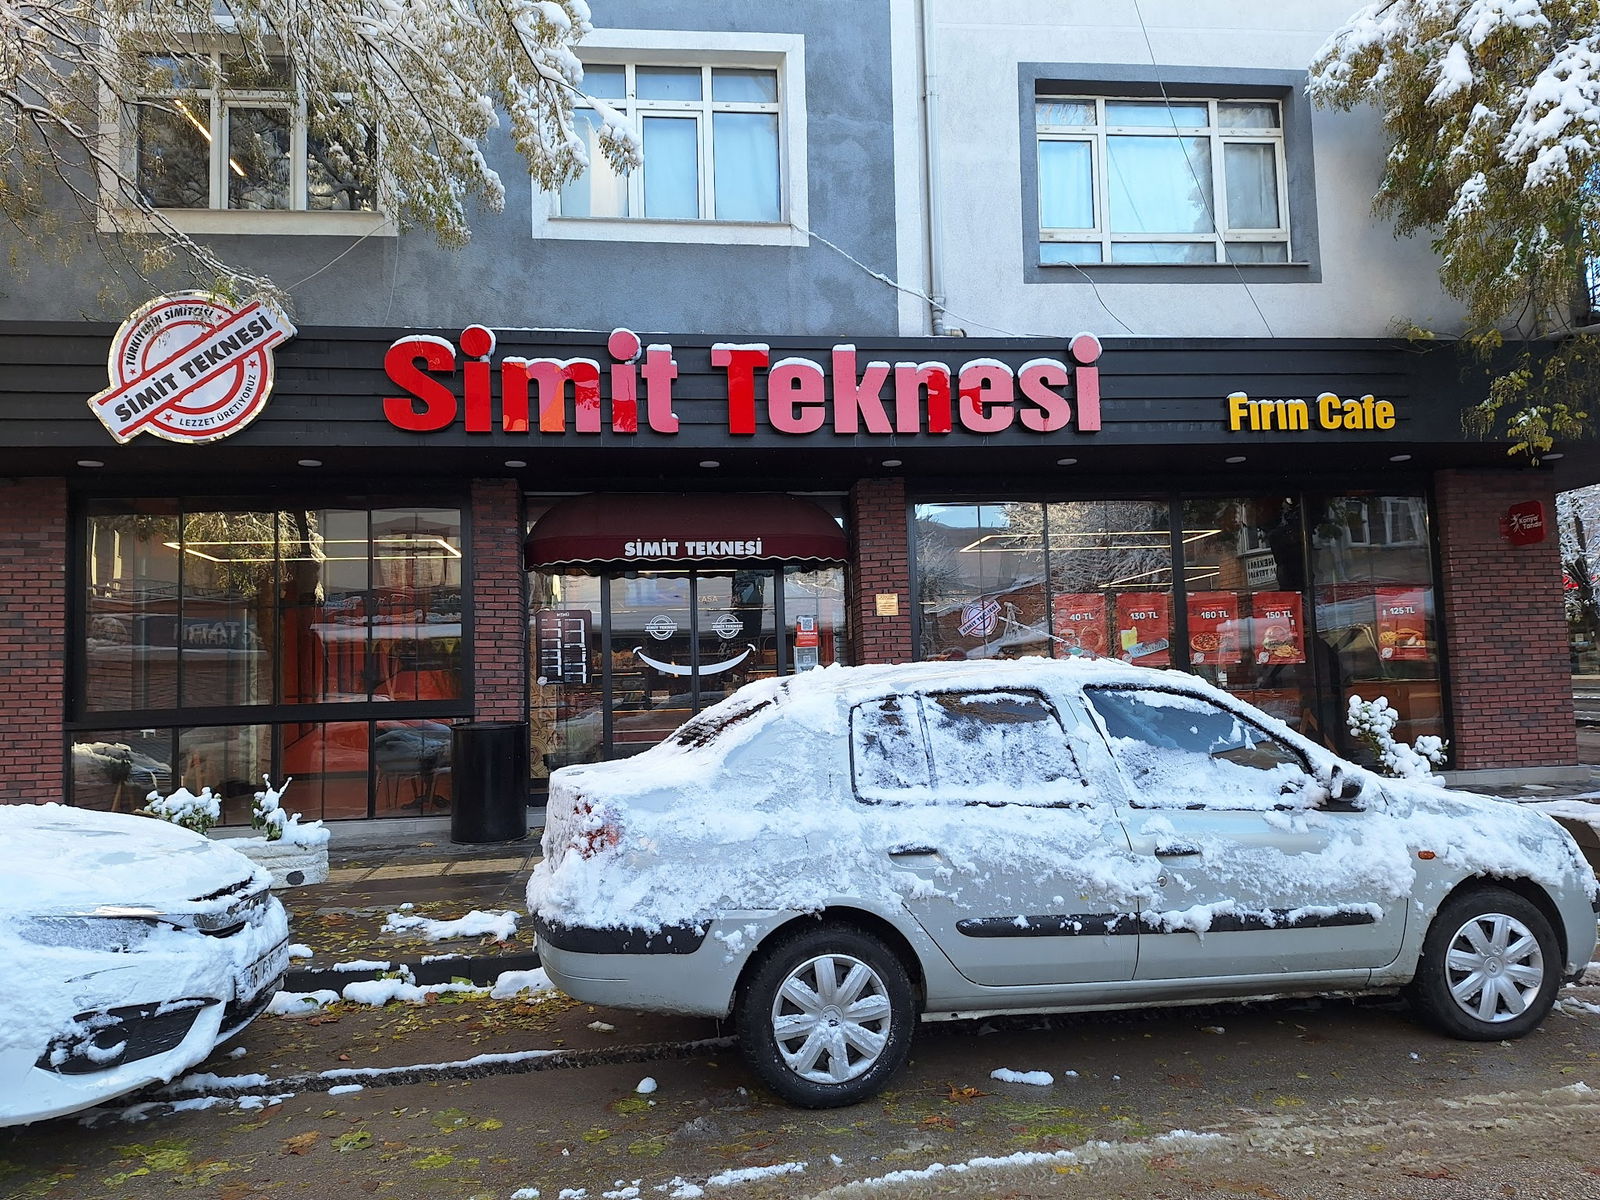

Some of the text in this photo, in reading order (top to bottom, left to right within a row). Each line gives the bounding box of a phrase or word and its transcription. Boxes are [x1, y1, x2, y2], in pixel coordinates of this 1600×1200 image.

[115, 311, 273, 422] SİMİT TEKNESİ
[382, 327, 1101, 435] Simit Teknesi
[180, 374, 257, 427] LEZZET ÜRETİYORUZ
[1316, 393, 1396, 430] Cafe
[625, 537, 762, 556] SİMİT TEKNESİ
[1069, 612, 1095, 622] 40 TL
[1147, 611, 1159, 619] TL
[1218, 610, 1230, 618] TL
[1265, 609, 1293, 619] 150 TL
[1389, 605, 1416, 615] 125 TL
